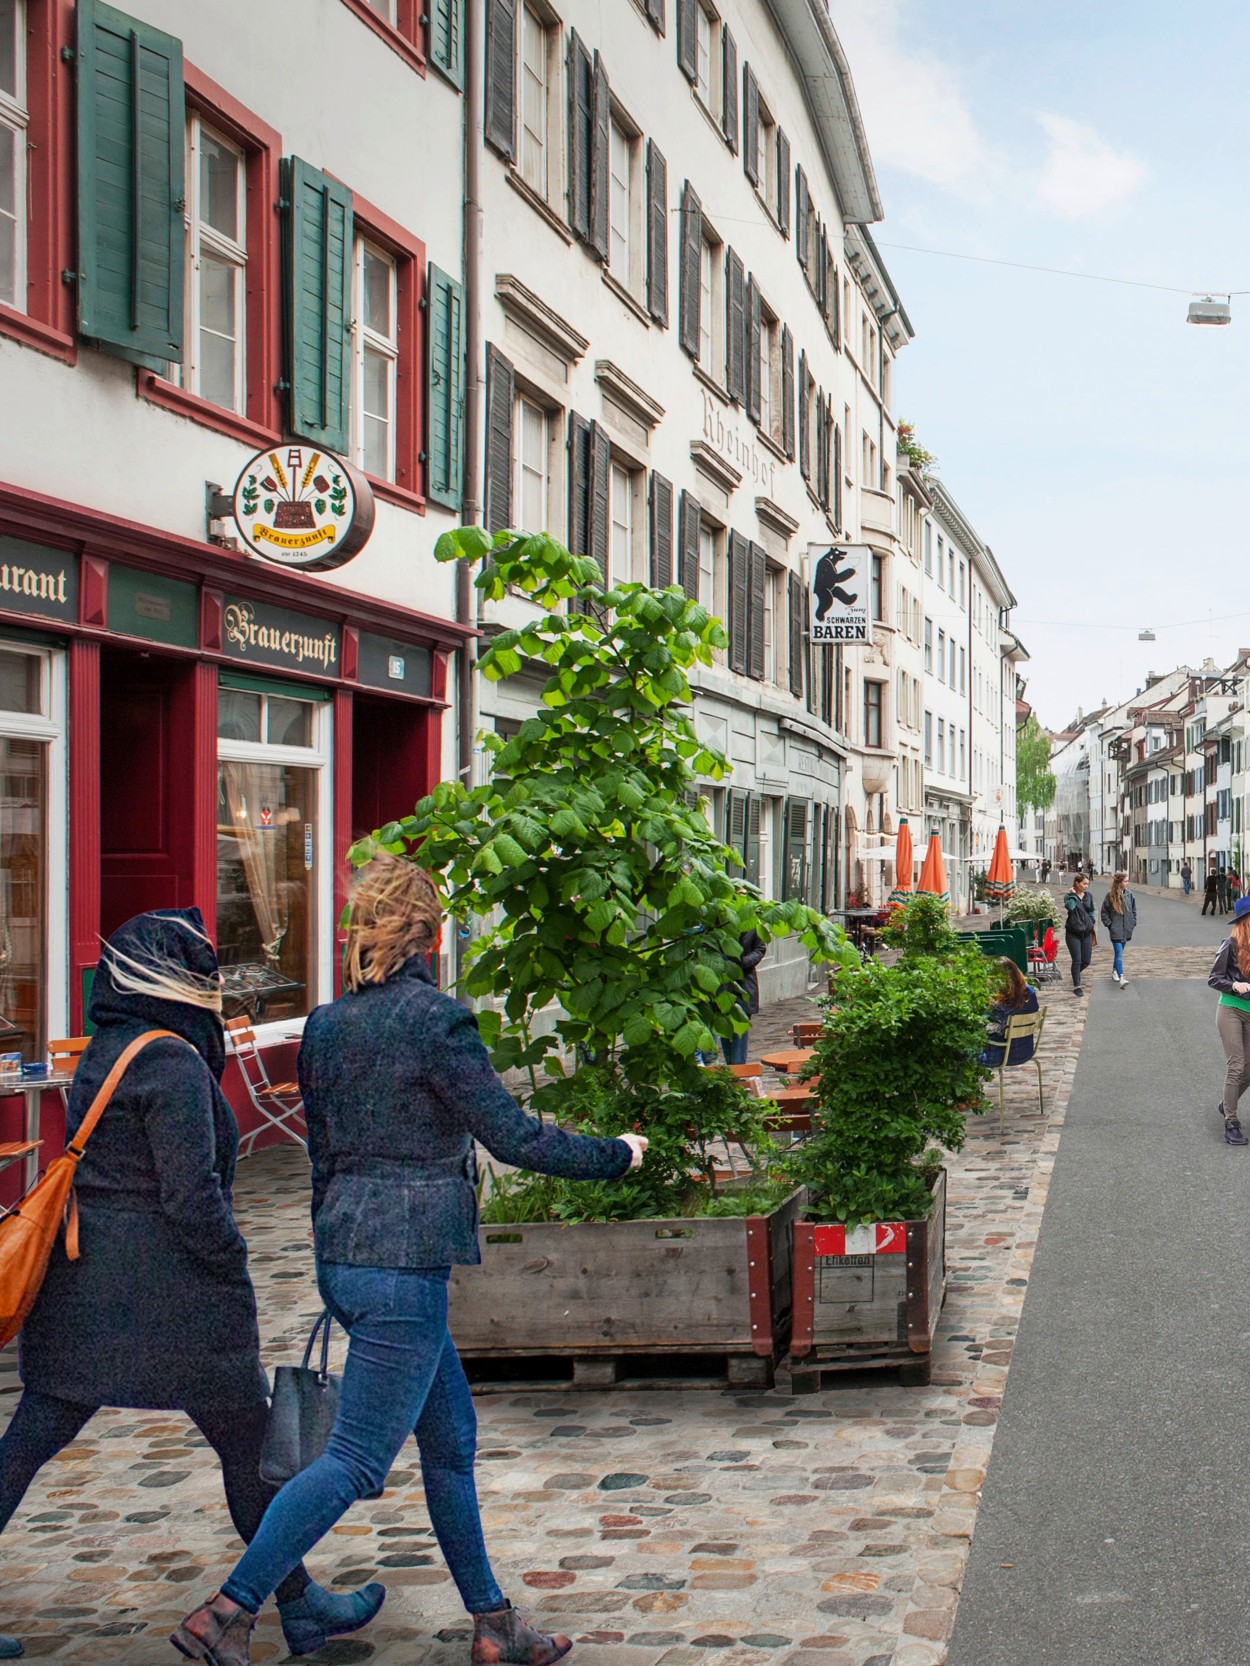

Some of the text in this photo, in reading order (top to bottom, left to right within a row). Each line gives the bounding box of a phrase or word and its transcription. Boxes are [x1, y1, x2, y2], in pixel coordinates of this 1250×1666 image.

[700, 387, 776, 500] Rheinhof
[259, 526, 328, 547] Brauerzunft
[826, 616, 867, 624] SCHWARZEN
[224, 601, 337, 670] Brauerzunft
[391, 660, 401, 674] 15
